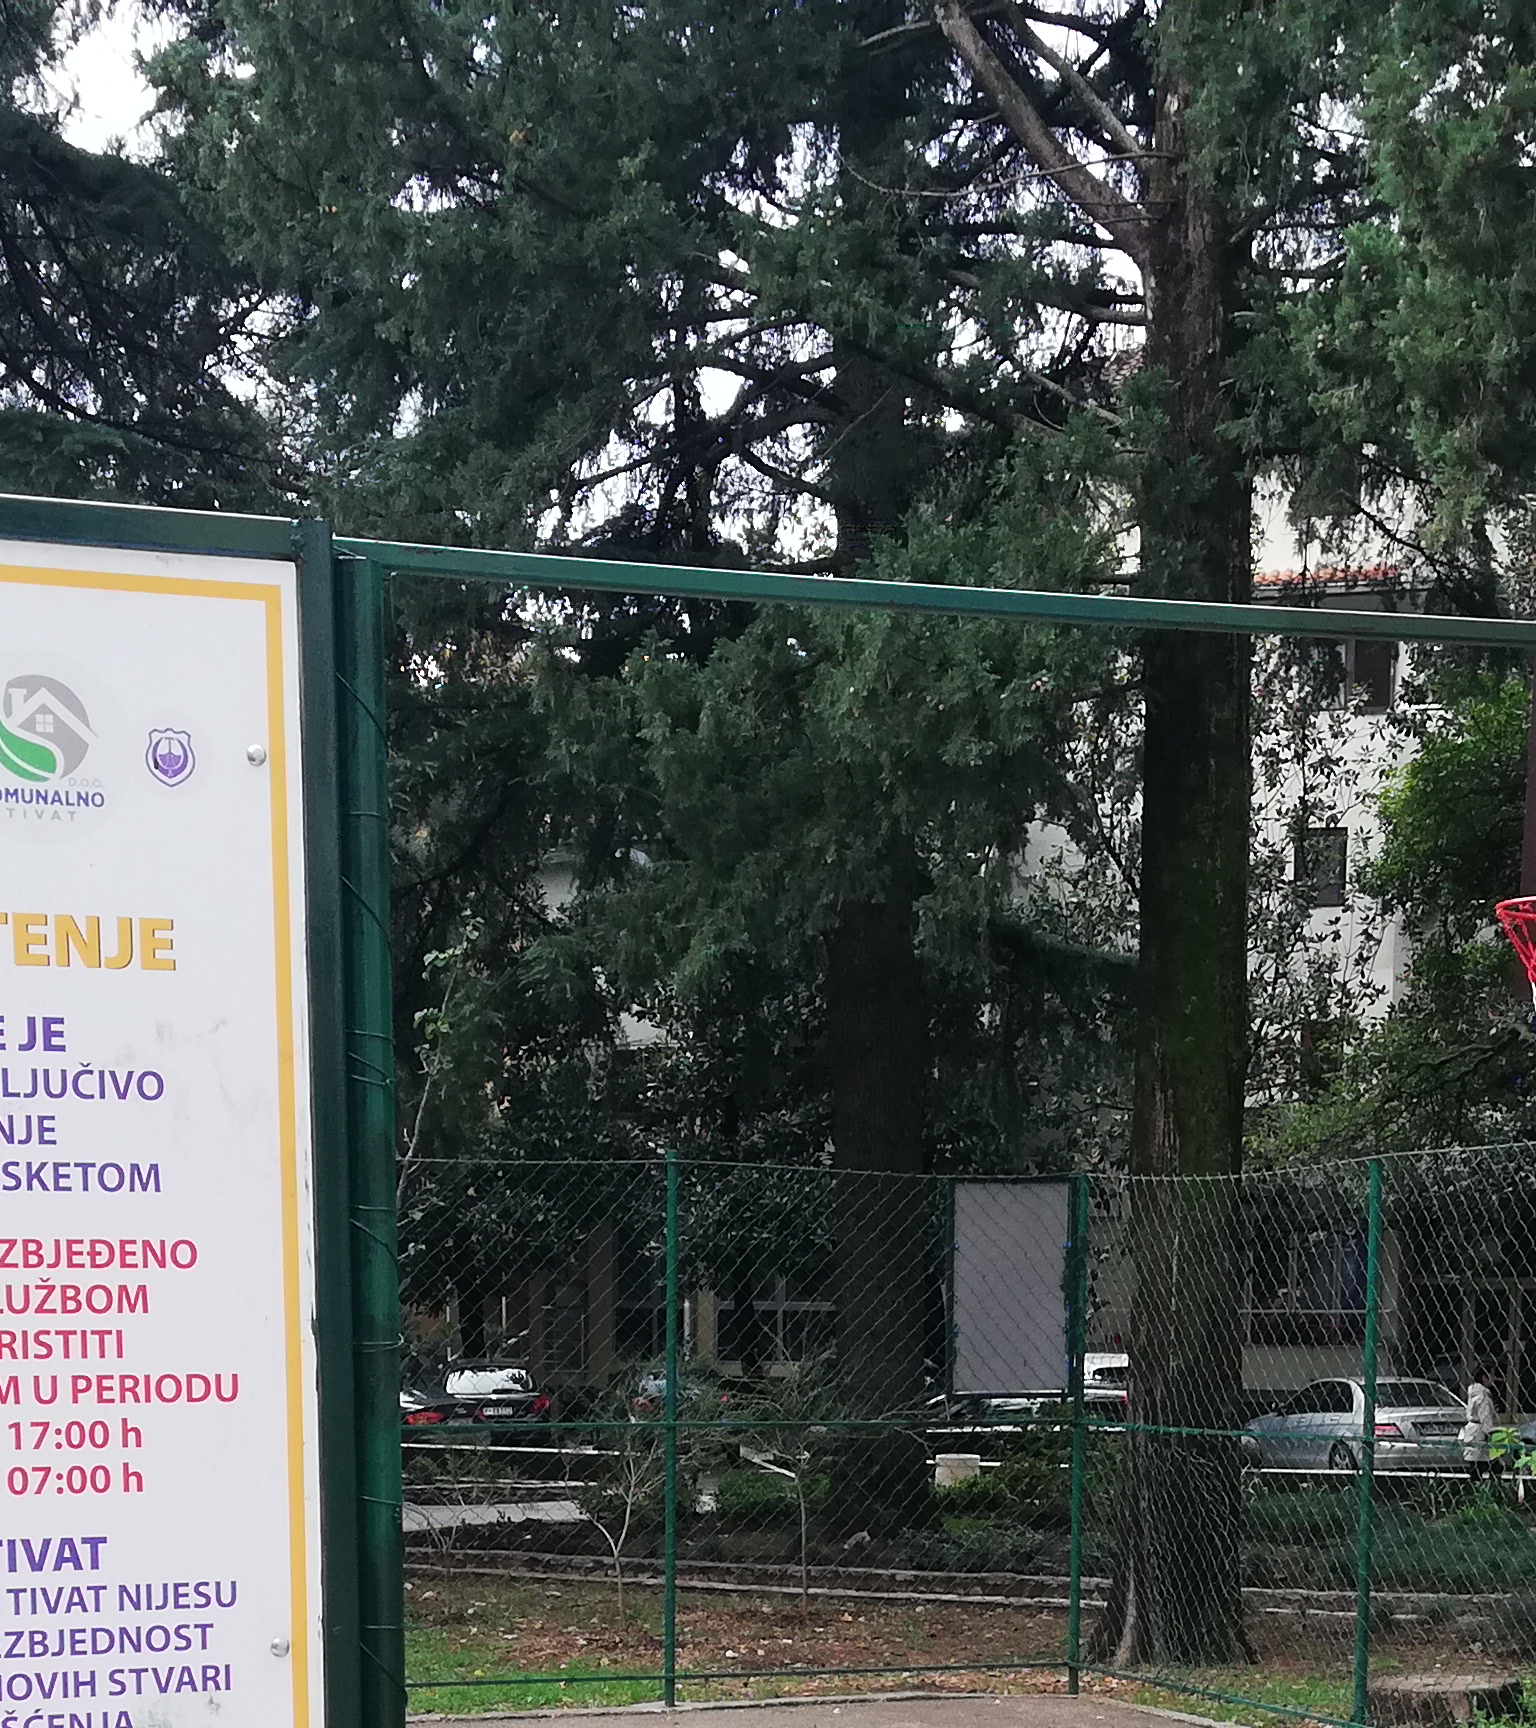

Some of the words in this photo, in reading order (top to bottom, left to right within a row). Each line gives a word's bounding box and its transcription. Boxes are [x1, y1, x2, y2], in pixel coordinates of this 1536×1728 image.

[6, 807, 77, 821] TIVAT
[17, 1015, 67, 1053] JE
[32, 1374, 58, 1405] U
[70, 1373, 239, 1405] PERIODU
[7, 1420, 110, 1451] 17:00
[120, 1417, 142, 1449] h
[7, 1464, 111, 1496] 07:00
[122, 1461, 144, 1493] h
[5, 1584, 108, 1616] TIVAT
[118, 1580, 237, 1612] NIJESU
[108, 1663, 232, 1697] STVARI
